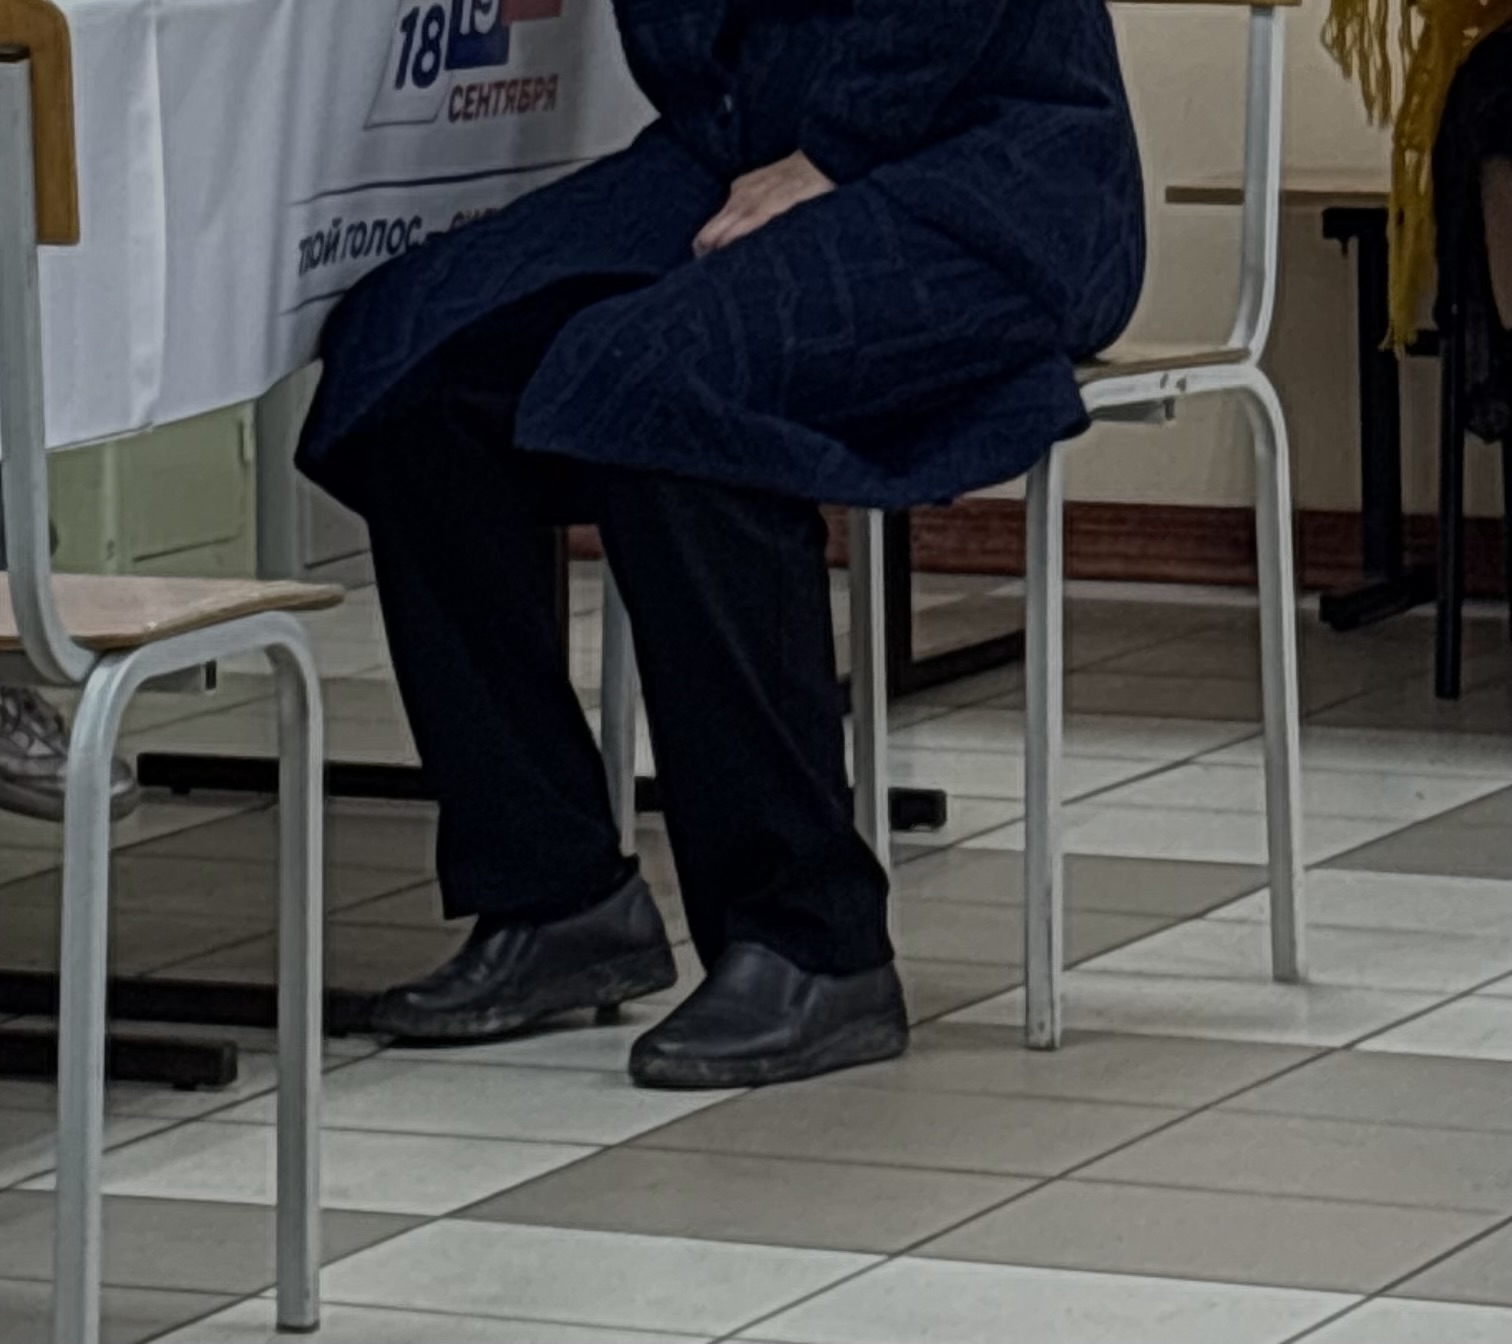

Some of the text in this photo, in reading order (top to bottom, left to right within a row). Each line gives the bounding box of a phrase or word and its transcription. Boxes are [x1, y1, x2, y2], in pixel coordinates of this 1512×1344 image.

[394, 4, 445, 90] 18
[448, 75, 558, 123] СЕНТЯБРЯ
[341, 215, 423, 259] ГОЛОС
